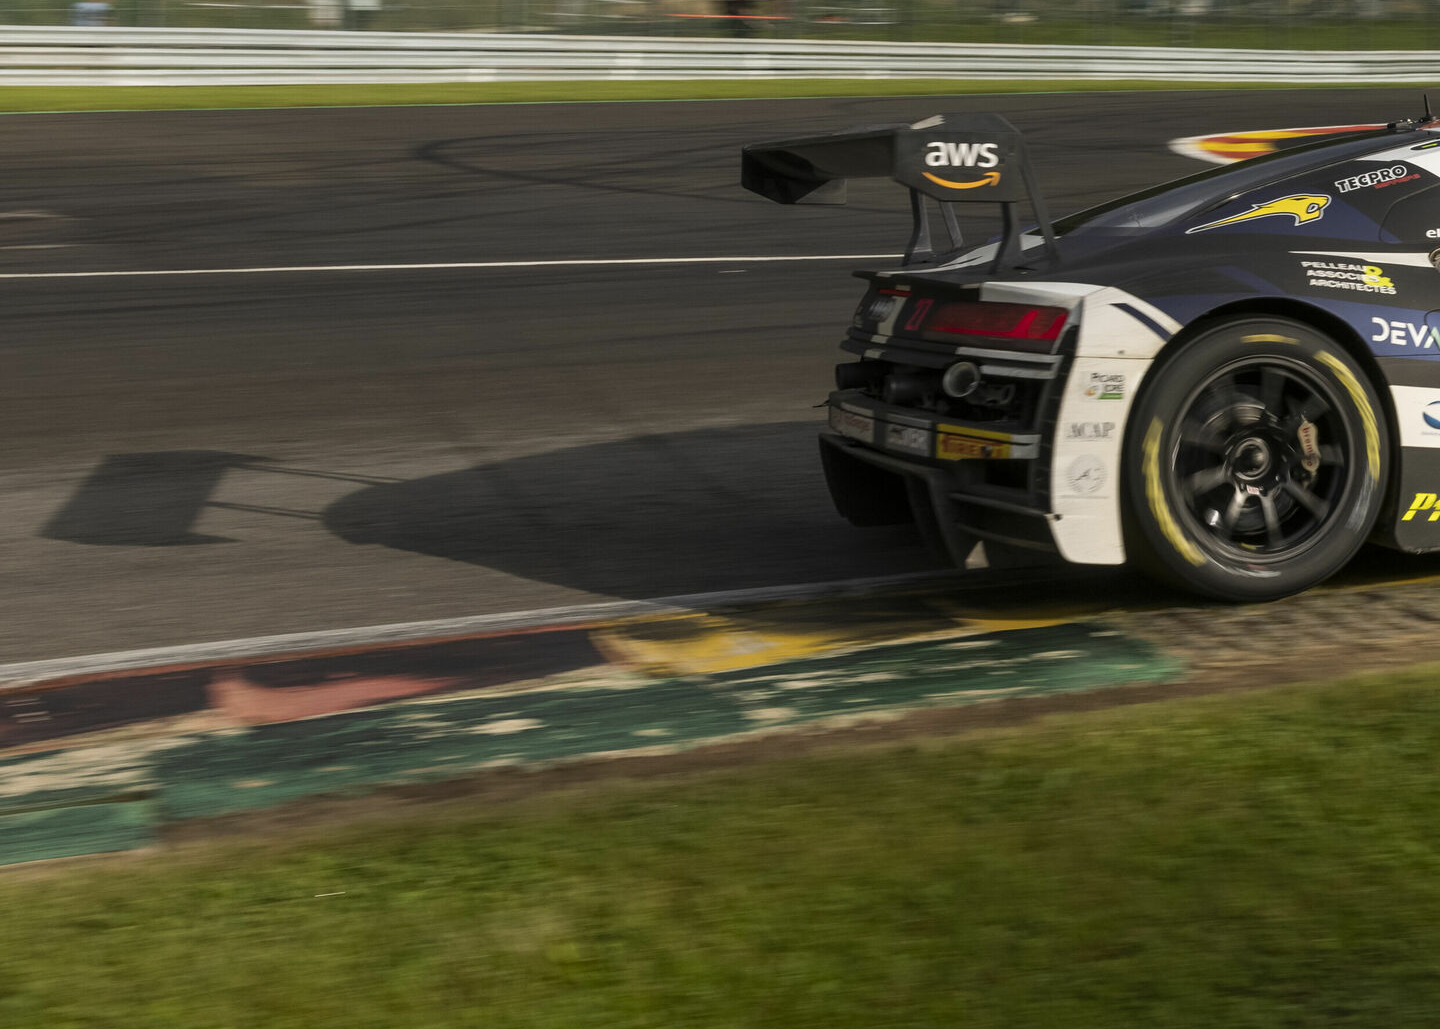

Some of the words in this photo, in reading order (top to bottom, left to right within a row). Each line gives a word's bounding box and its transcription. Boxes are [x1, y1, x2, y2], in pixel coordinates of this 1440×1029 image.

[925, 141, 999, 168] aws
[1334, 165, 1407, 193] TECPRO
[1300, 261, 1367, 273] PELLEAU
[1308, 279, 1398, 295] ARCHITECTES
